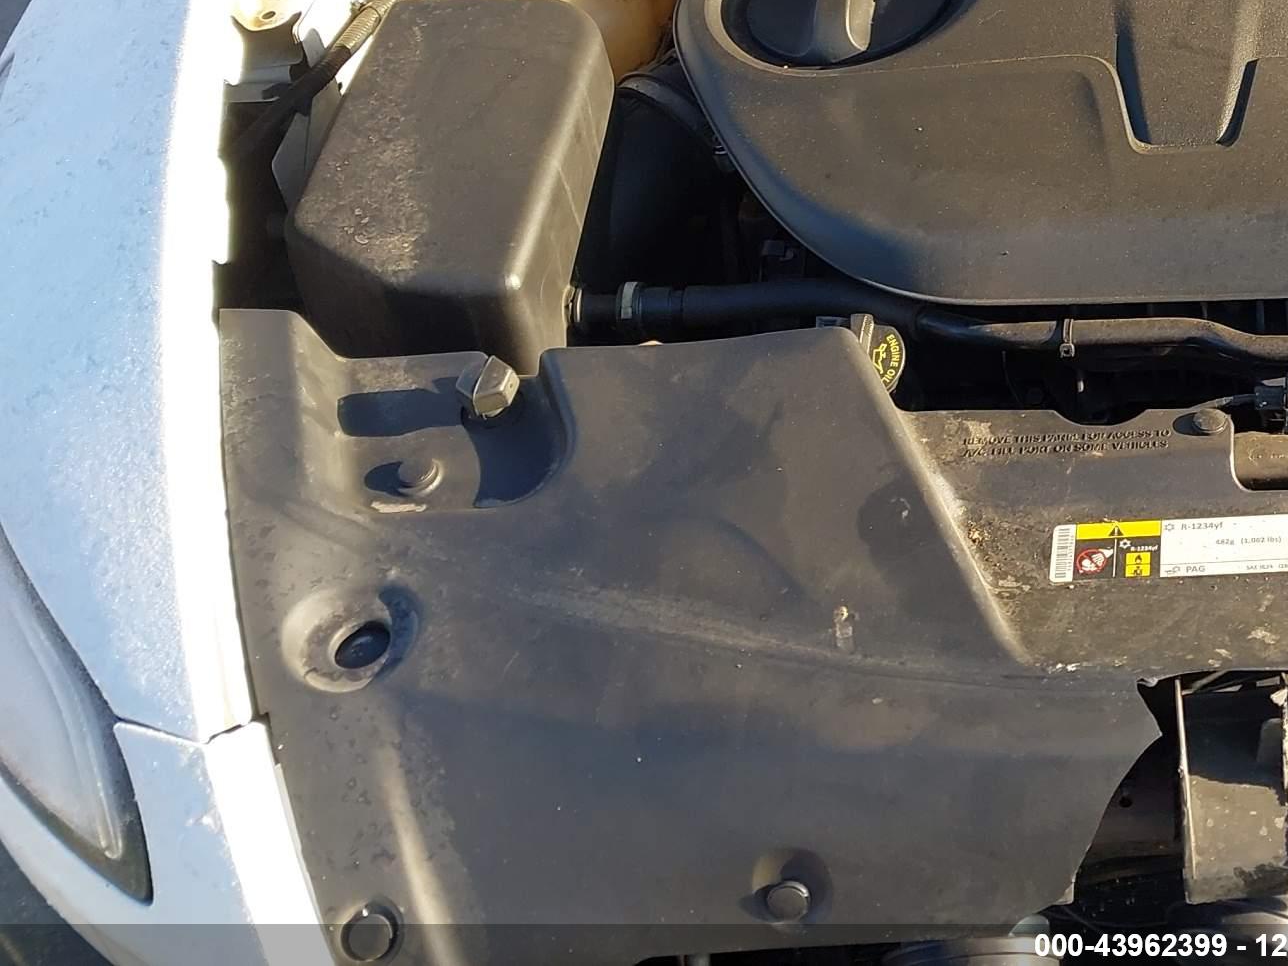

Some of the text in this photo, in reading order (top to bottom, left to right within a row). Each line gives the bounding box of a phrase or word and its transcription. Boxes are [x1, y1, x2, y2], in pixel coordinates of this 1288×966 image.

[881, 334, 901, 383] ENGINE OIL
[963, 429, 1171, 446] REMOVE THIS PANEL FOR ACCESS TO
[990, 446, 1015, 455] FILL
[1020, 445, 1050, 455] PORT
[1053, 444, 1073, 453] ON
[1073, 442, 1106, 452] SOME
[1112, 440, 1169, 450] VEHICLES
[1181, 522, 1223, 531] R-1234yf
